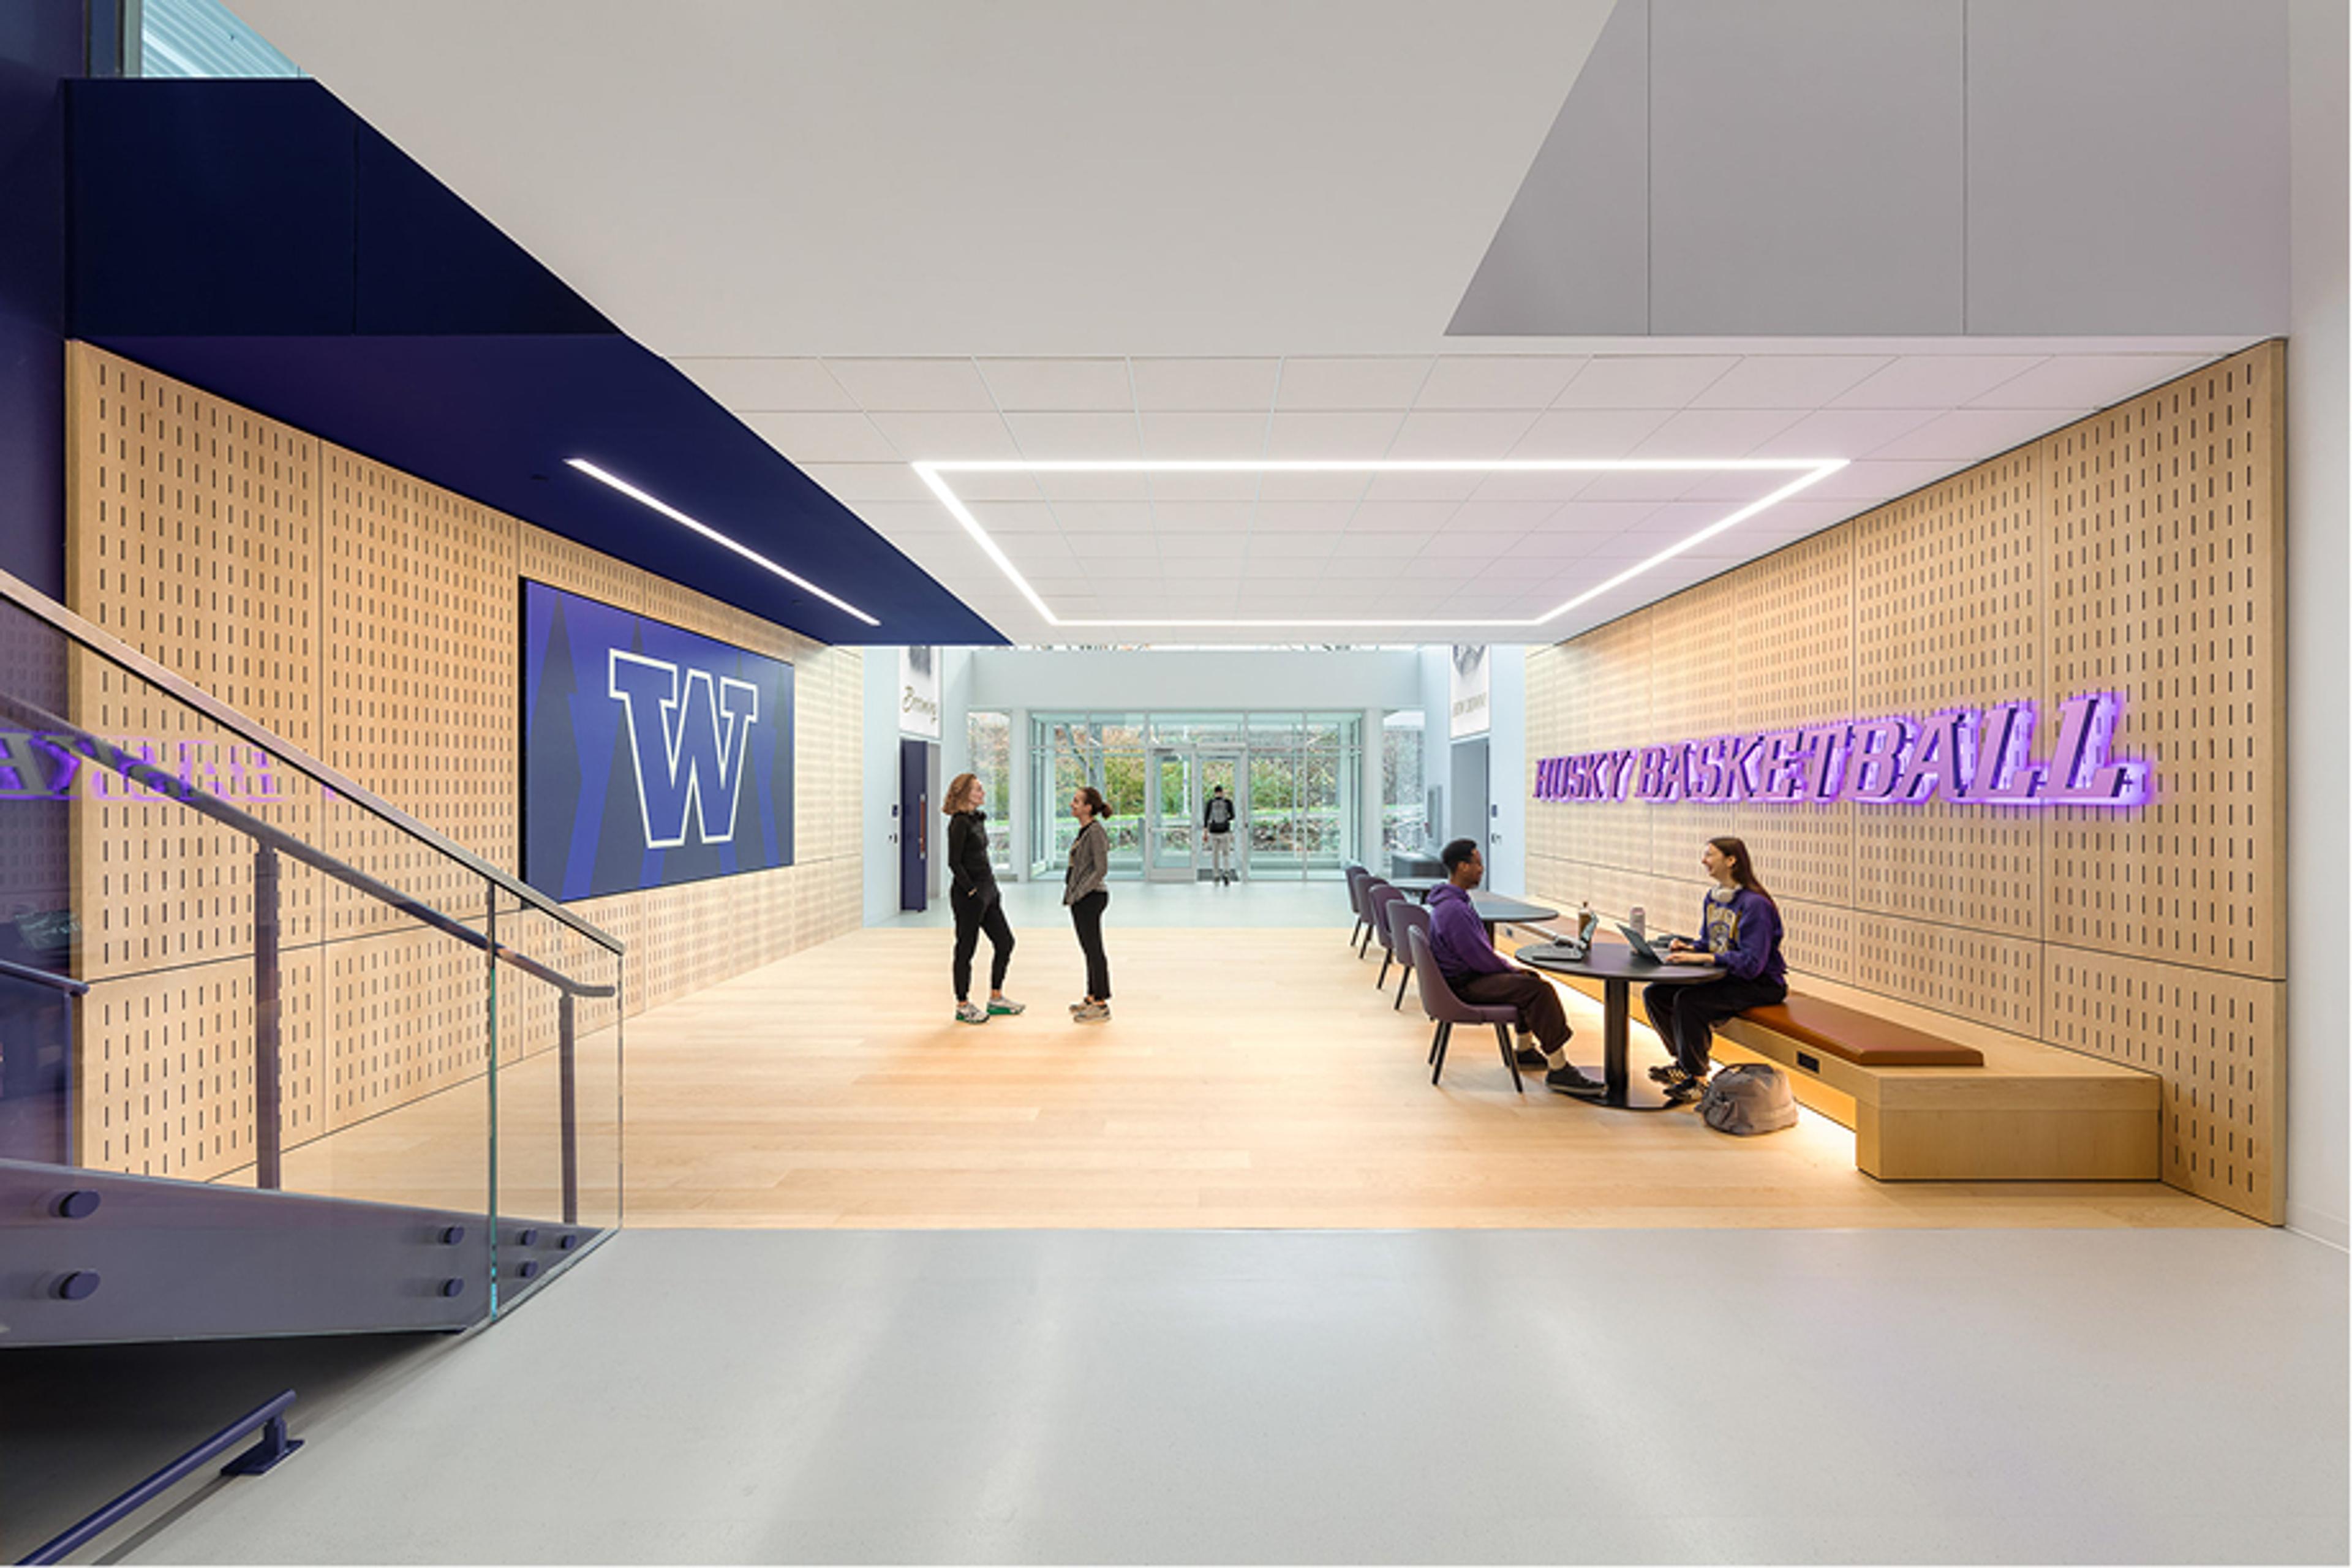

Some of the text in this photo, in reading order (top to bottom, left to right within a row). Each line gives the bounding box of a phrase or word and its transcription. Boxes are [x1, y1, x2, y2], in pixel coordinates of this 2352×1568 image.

[609, 648, 758, 849] W
[1532, 698, 2127, 798] HUSKY BASKETBALL
